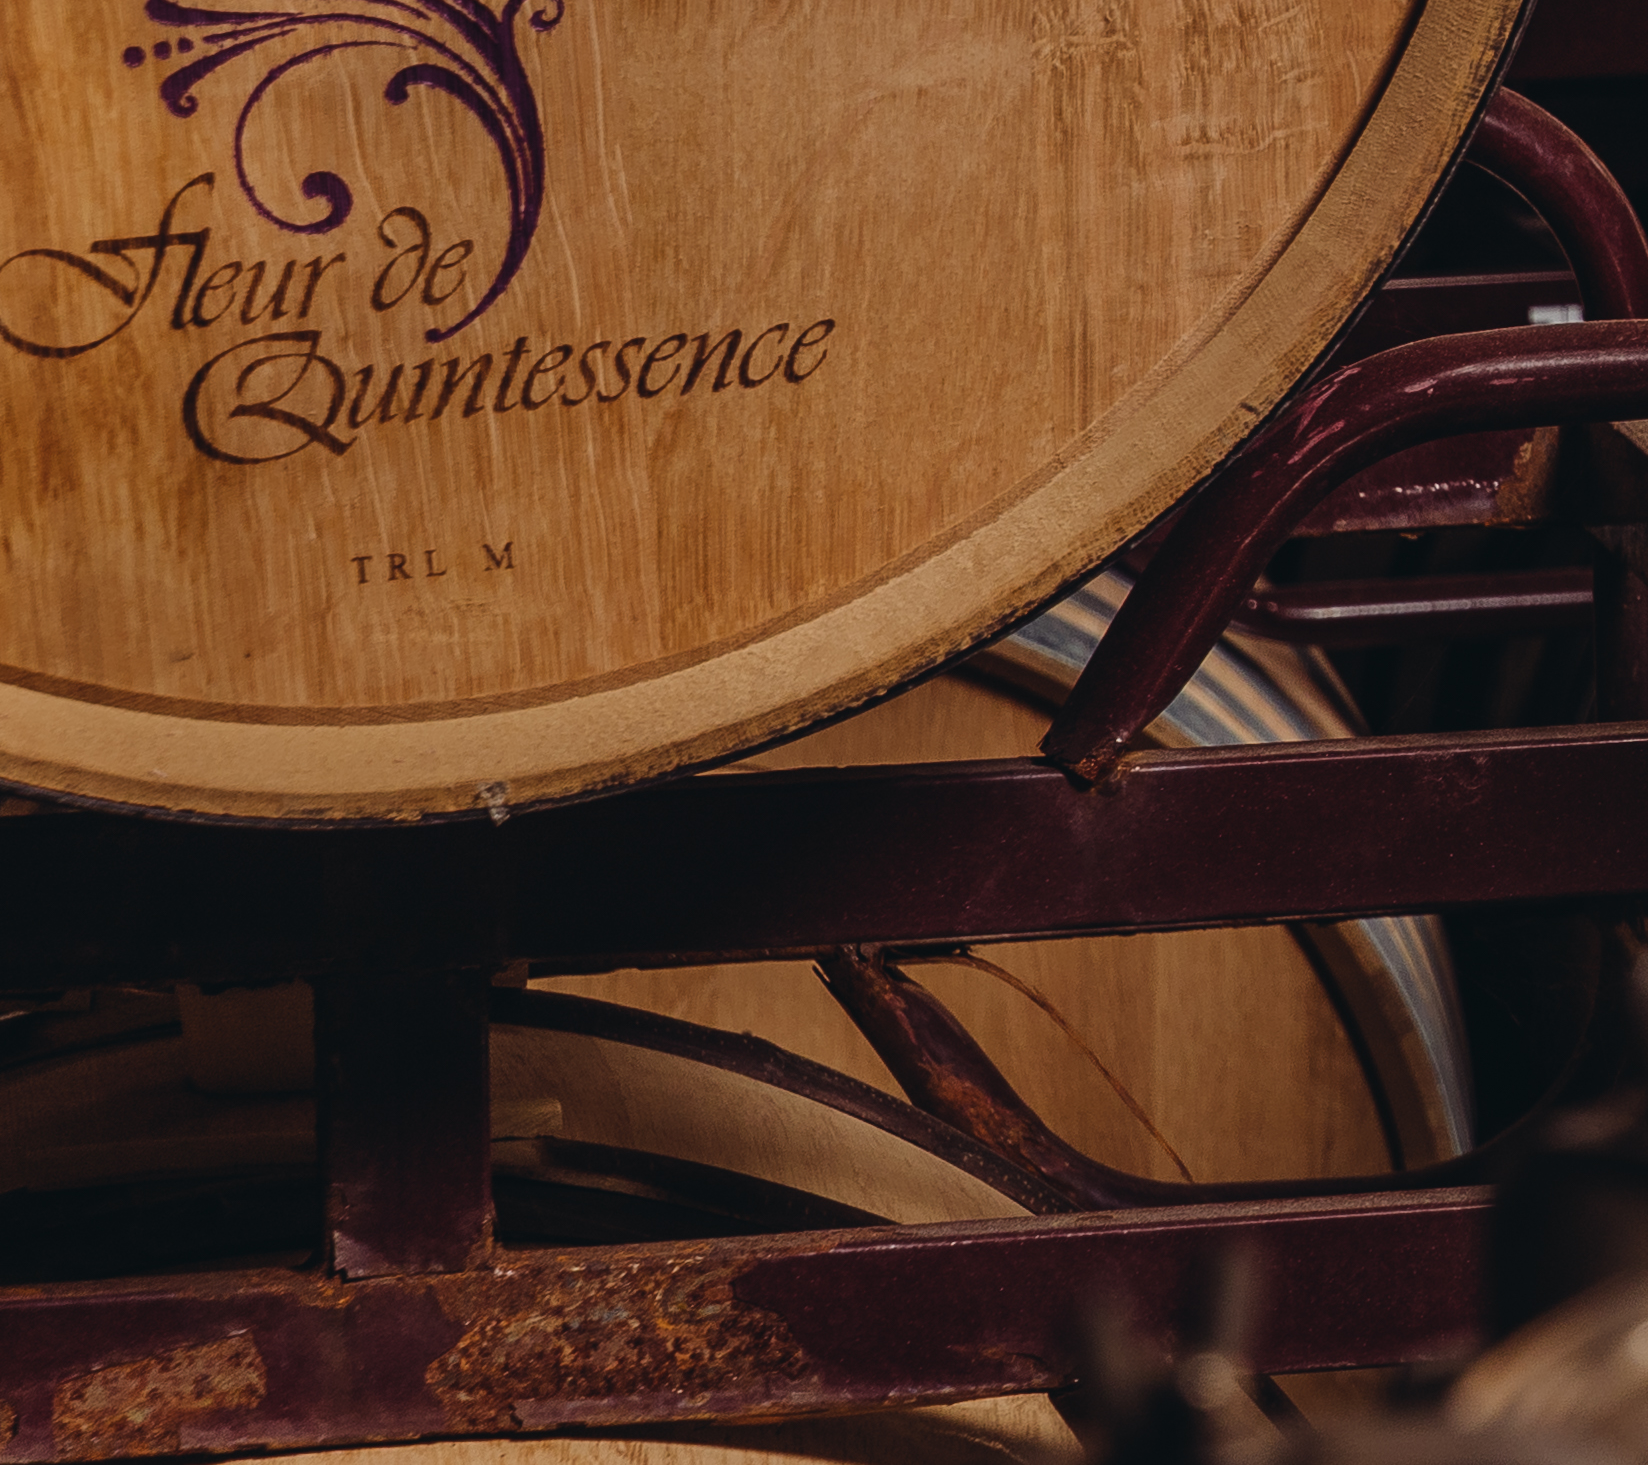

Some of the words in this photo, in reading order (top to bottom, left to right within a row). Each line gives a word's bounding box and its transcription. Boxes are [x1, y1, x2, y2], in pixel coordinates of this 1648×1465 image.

[0, 171, 347, 360] Fleur
[370, 205, 475, 312] de
[182, 317, 837, 466] Quintessence
[351, 549, 448, 585] TRL
[482, 540, 516, 572] M
